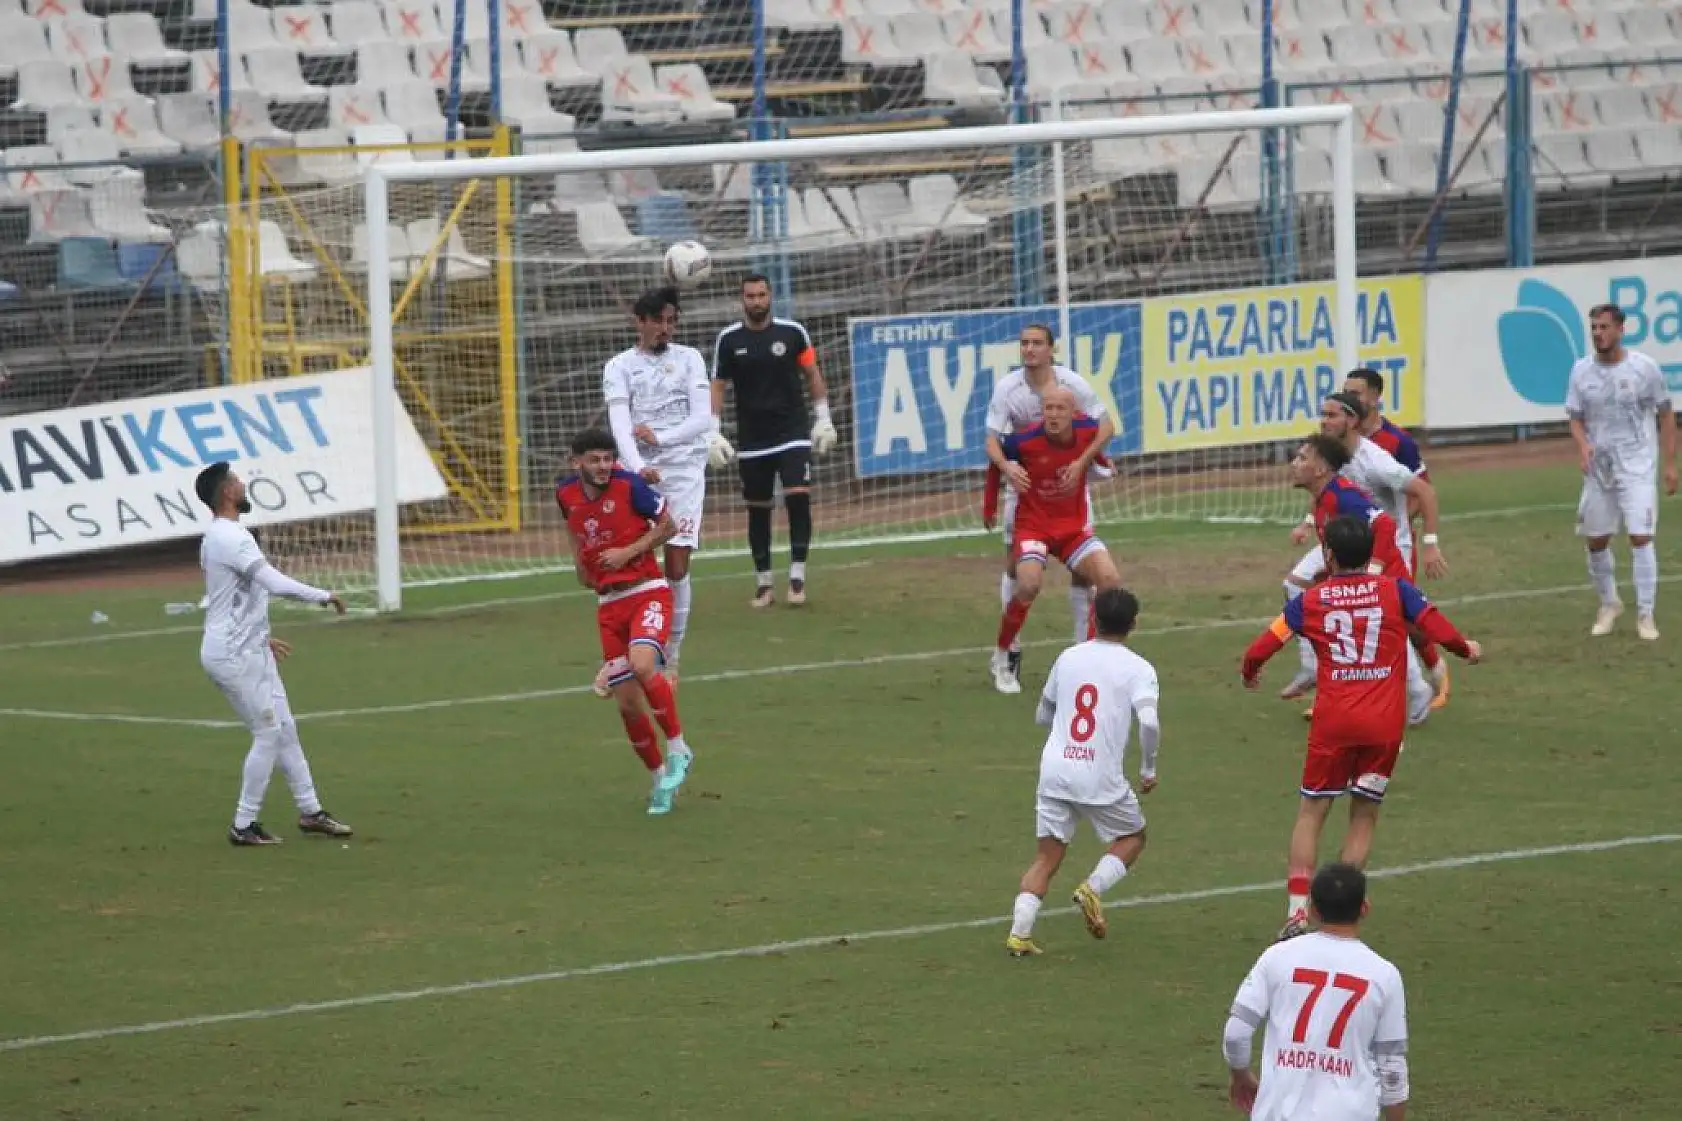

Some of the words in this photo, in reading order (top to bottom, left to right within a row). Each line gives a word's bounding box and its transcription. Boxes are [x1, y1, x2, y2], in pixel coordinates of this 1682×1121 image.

[873, 332, 1124, 456] AYTK
[1157, 373, 1240, 434] YAPI
[28, 470, 337, 545] ASANÖR
[1320, 582, 1378, 599] ESNAF
[1324, 607, 1382, 664] 37
[1070, 683, 1098, 743] 8
[1292, 967, 1369, 1049] 77
